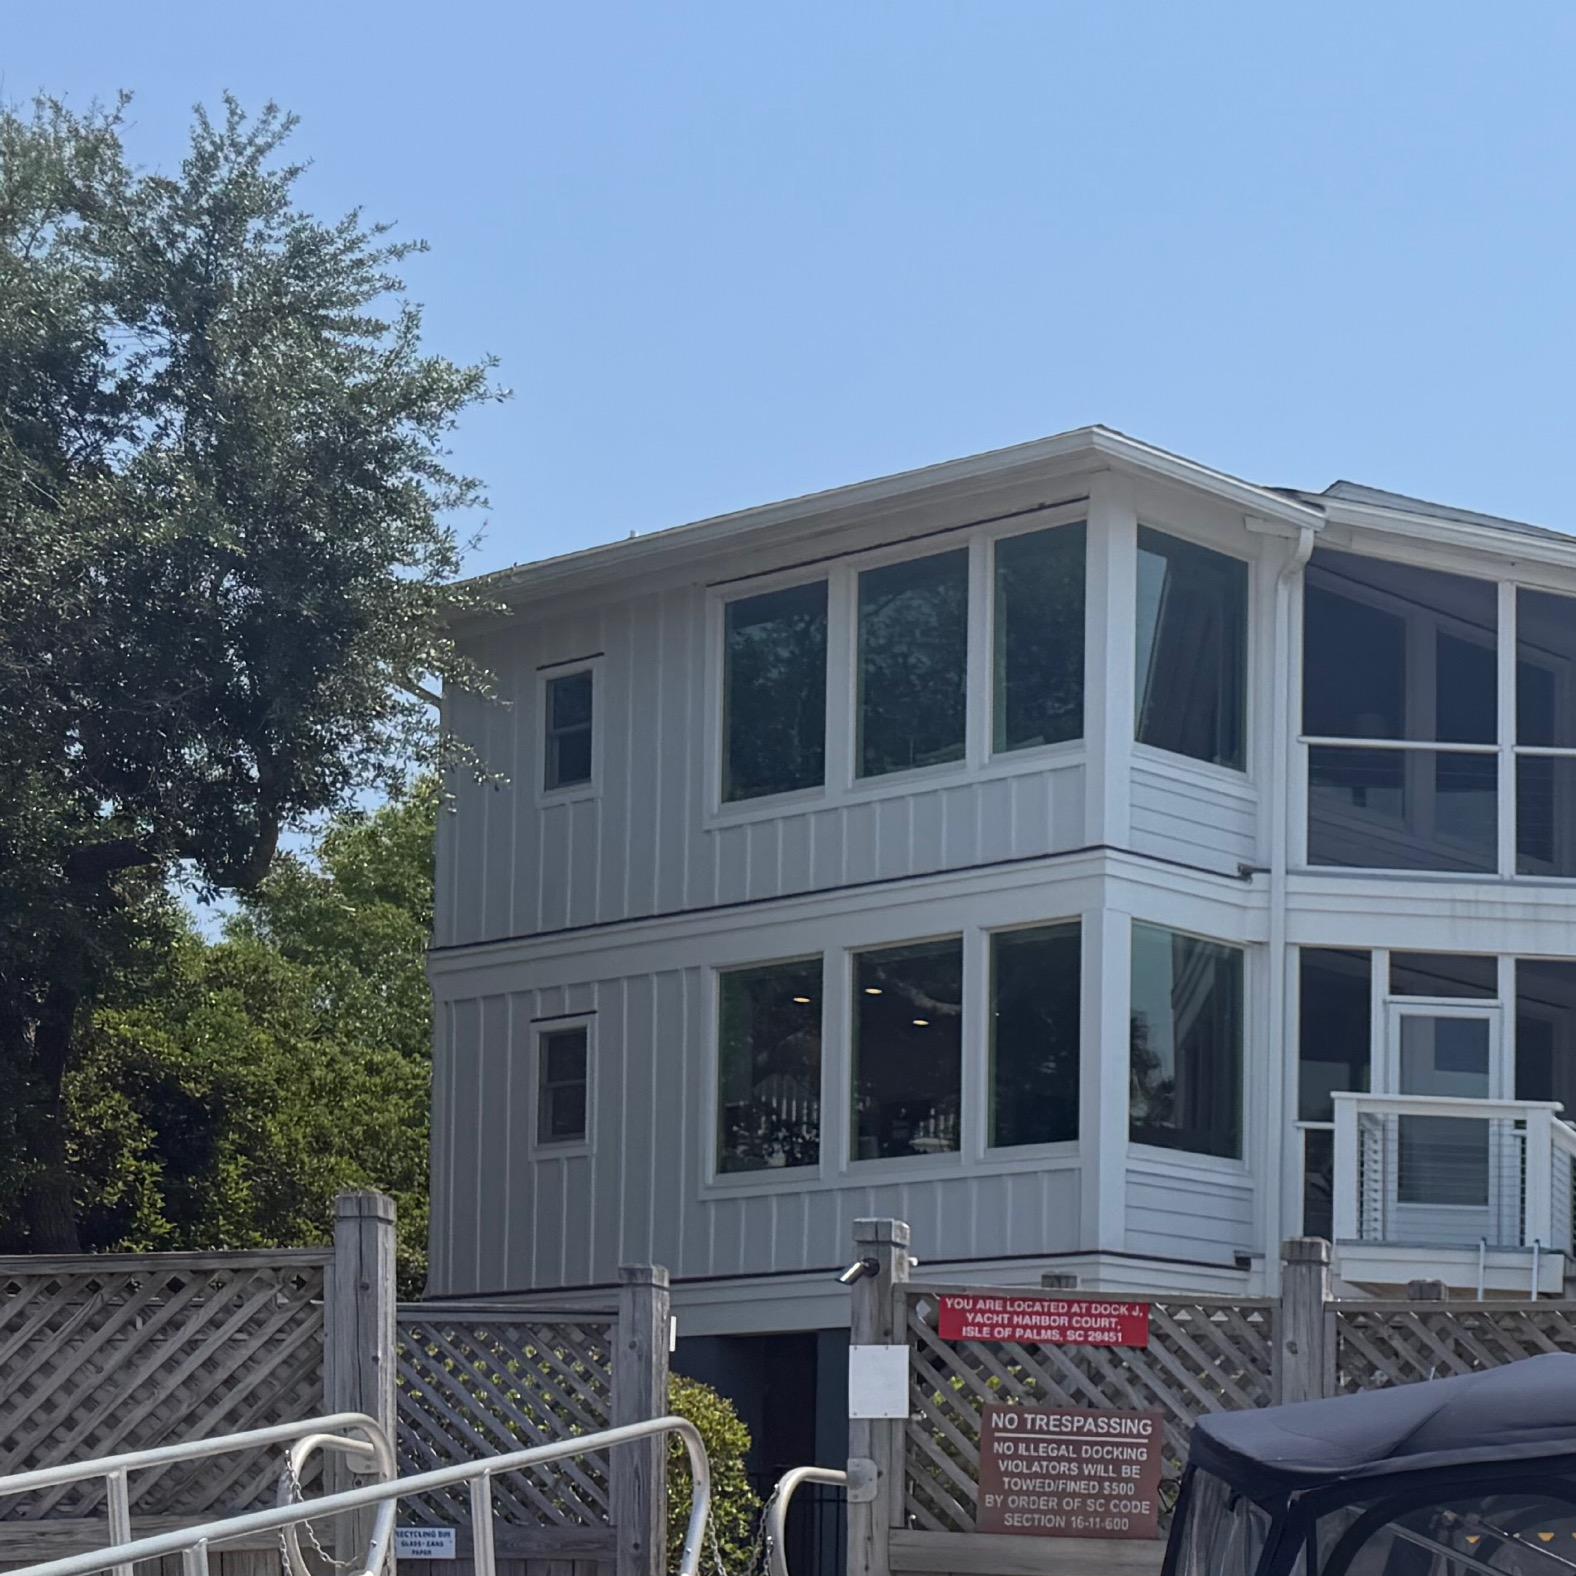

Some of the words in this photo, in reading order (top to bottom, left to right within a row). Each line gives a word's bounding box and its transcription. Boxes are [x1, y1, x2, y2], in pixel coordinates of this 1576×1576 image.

[945, 1298, 973, 1310] YOU
[979, 1300, 1002, 1311] ARE
[1006, 1301, 1067, 1312] LOCATED
[1070, 1302, 1089, 1313] AT
[1091, 1303, 1129, 1315] DOCK
[966, 1312, 1009, 1325] YACHT
[1013, 1314, 1069, 1326] HARBOR
[962, 1327, 991, 1338] ISLE
[994, 1328, 1012, 1339] OF
[1066, 1330, 1085, 1341] SC
[1088, 1331, 1123, 1343] 29451
[991, 1412, 1018, 1429] NO
[1024, 1414, 1153, 1435] TRESPASSING
[993, 1442, 1014, 1454] NO
[1018, 1443, 1077, 1458] ILLEGAL
[1082, 1446, 1148, 1461] DOCKING
[998, 1460, 1079, 1475] VIOLATORS
[1083, 1463, 1116, 1477] WILL
[1121, 1465, 1141, 1478] BE
[1002, 1477, 1099, 1495] TOWED/FINED
[1103, 1482, 1135, 1495] $500
[985, 1495, 1003, 1508] BY
[1008, 1497, 1057, 1510] ORDER
[1063, 1500, 1082, 1511] OF
[1086, 1500, 1105, 1512] SC
[1110, 1501, 1150, 1514] CODE
[1004, 1514, 1066, 1528] SECTION
[1070, 1515, 1129, 1530] 16-11-600
